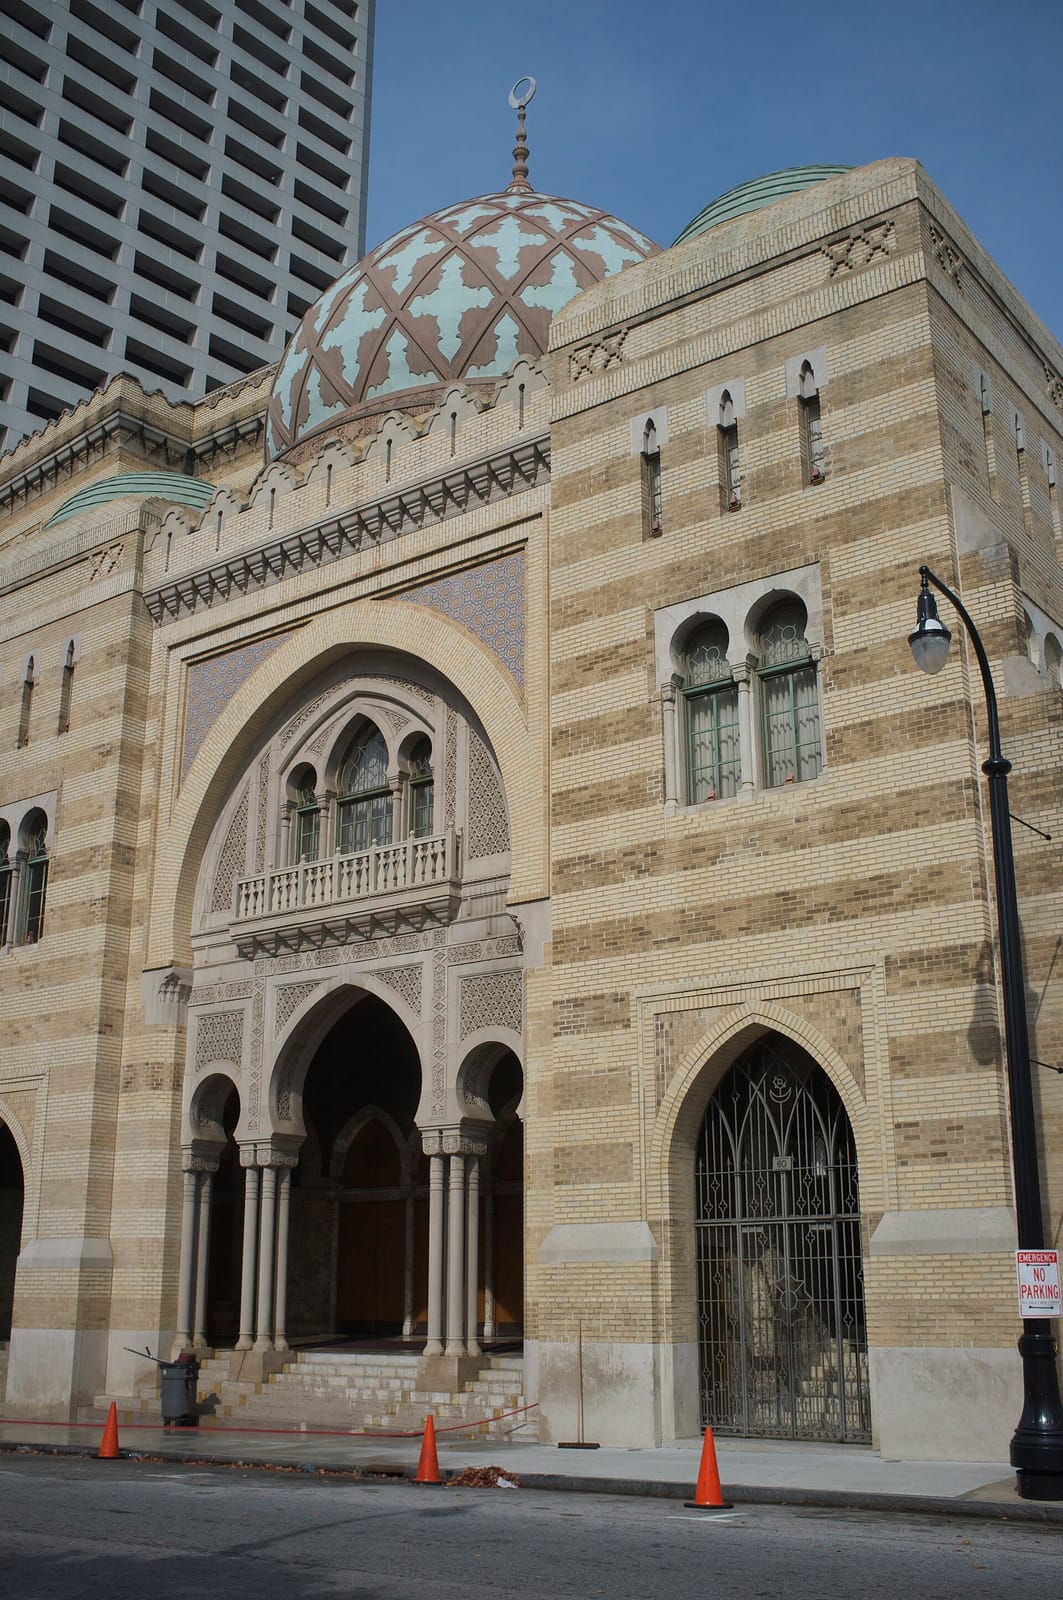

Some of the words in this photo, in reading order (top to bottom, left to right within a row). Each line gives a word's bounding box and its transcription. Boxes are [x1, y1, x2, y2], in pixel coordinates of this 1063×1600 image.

[1018, 1253, 1056, 1263] EMERGENCY
[1033, 1267, 1046, 1282] NO
[1021, 1285, 1059, 1299] PARKING
